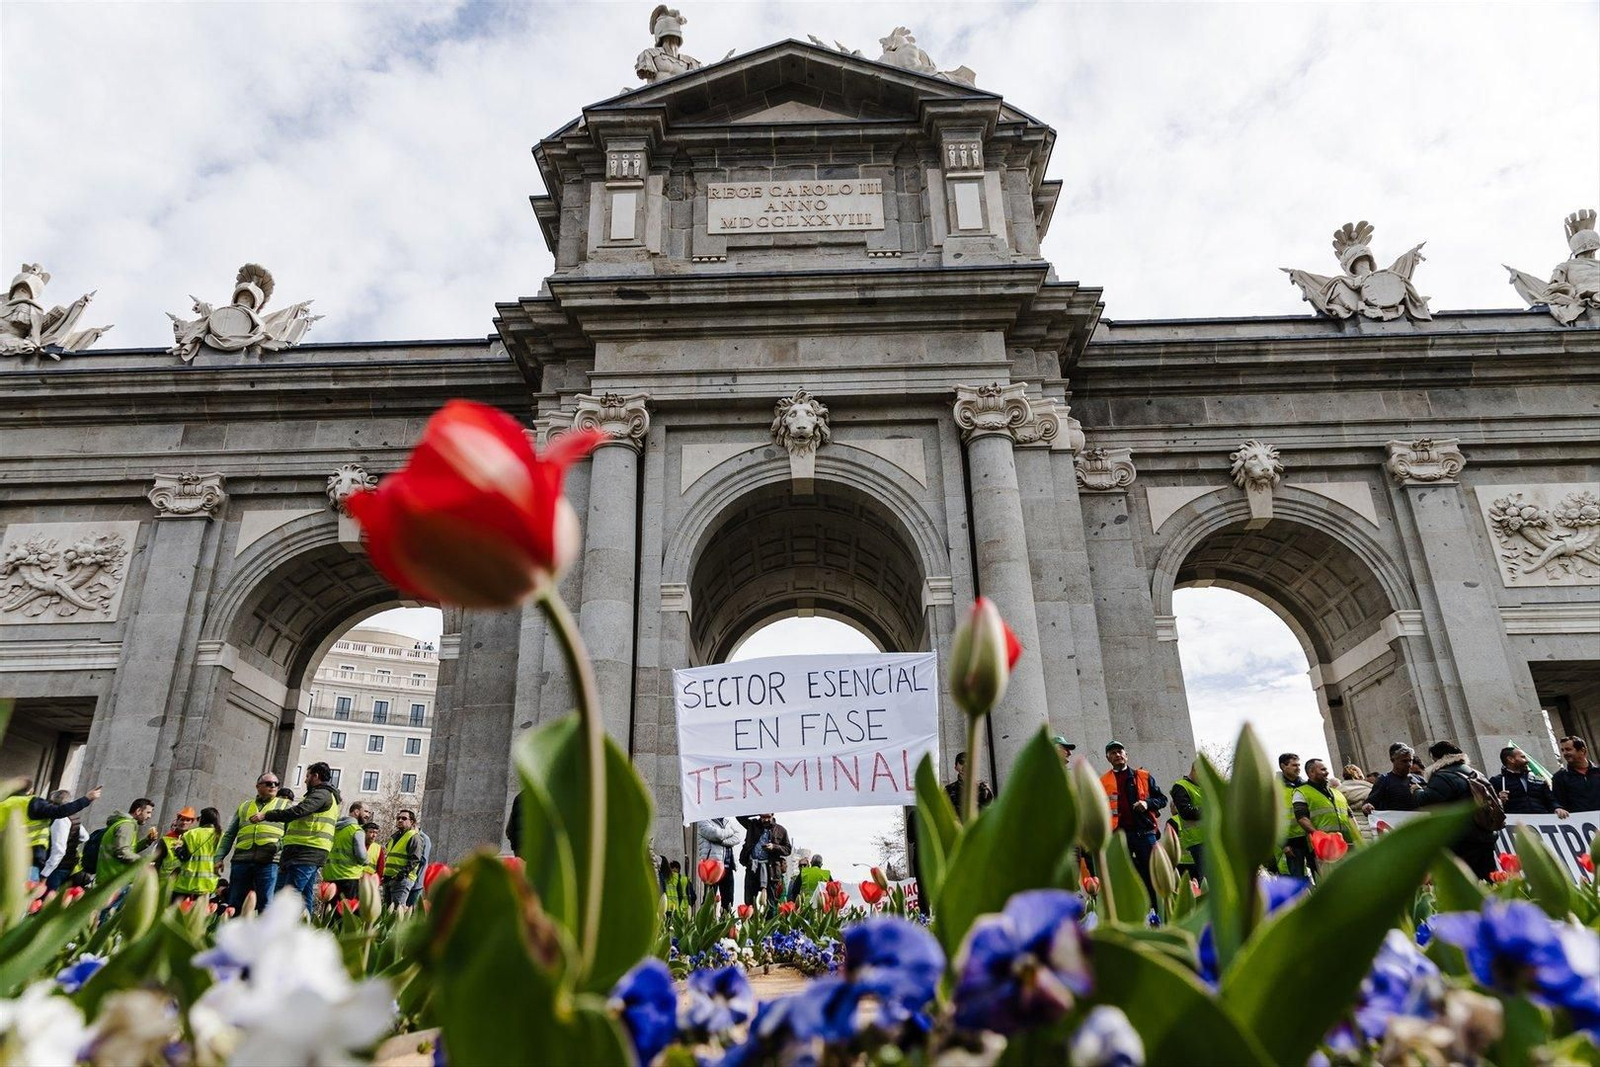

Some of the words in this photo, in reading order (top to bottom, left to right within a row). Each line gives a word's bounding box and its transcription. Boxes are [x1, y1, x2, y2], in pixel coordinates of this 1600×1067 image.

[709, 187, 763, 199] REGE
[769, 183, 853, 197] CAROLO
[860, 183, 882, 195] III
[764, 200, 828, 213] ANNO
[720, 214, 872, 230] MDCCLXXVIII
[683, 672, 786, 709] SECTOR
[734, 717, 780, 750] EN
[801, 709, 888, 746] FASE
[688, 750, 916, 804] TERMINAL
